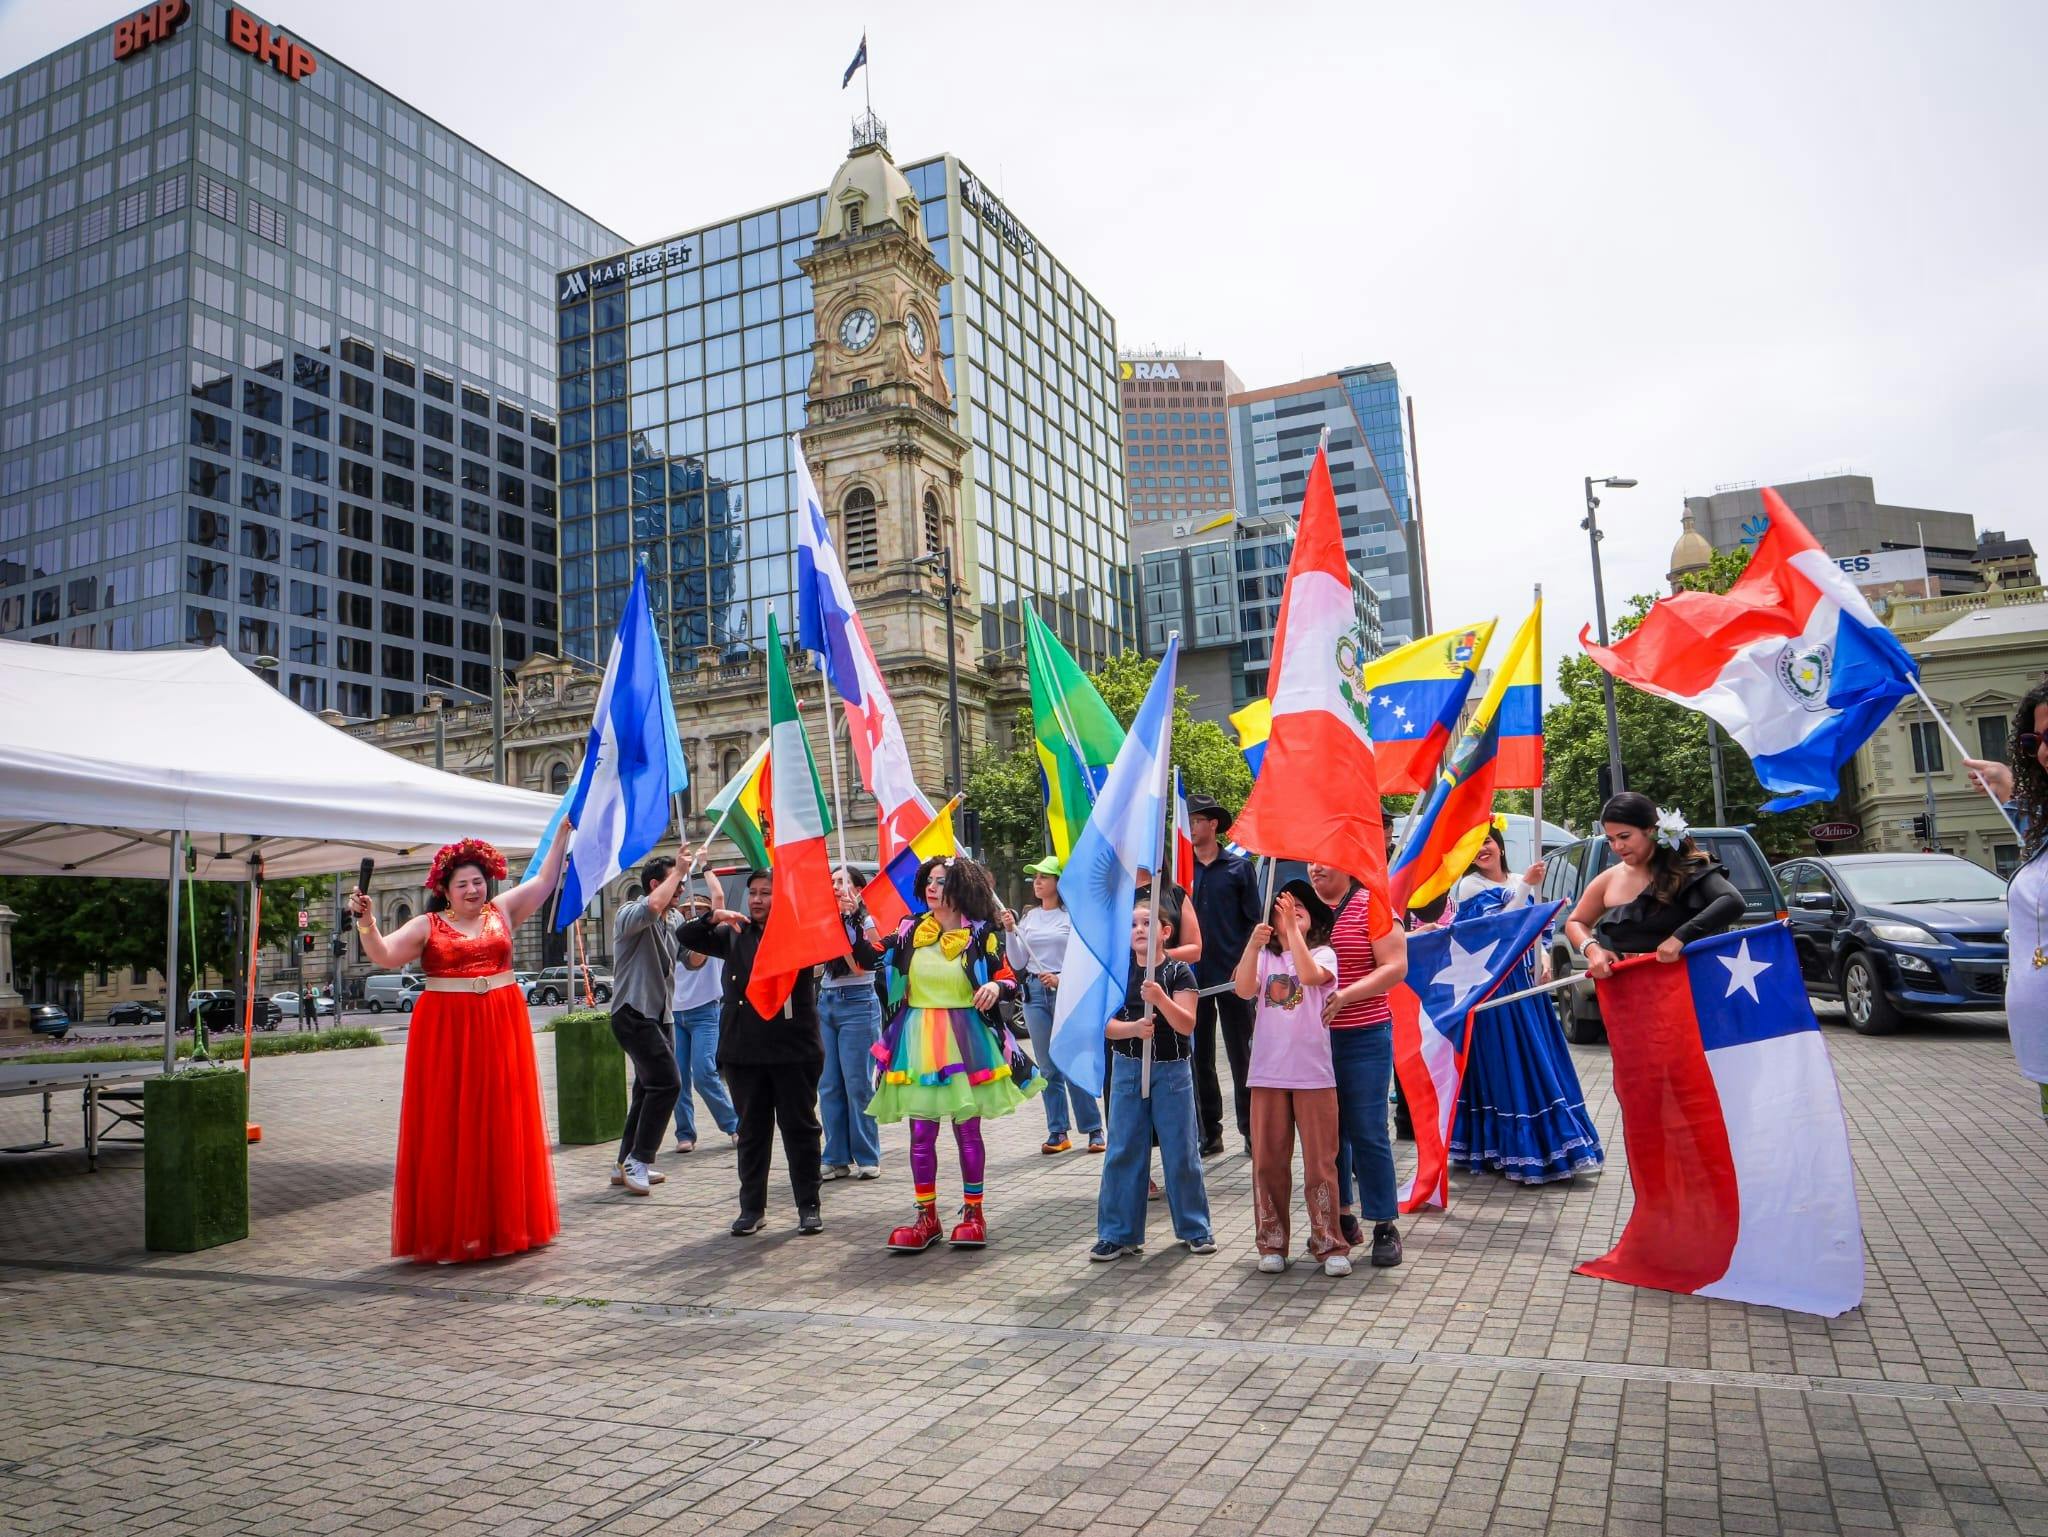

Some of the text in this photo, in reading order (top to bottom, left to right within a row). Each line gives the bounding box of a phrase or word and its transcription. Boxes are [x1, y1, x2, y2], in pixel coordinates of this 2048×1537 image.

[114, 0, 184, 60] BHP
[229, 6, 317, 81] BHP
[589, 244, 687, 285] MARRIOTT
[1135, 362, 1180, 380] RAA
[1815, 826, 1853, 837] Adina
